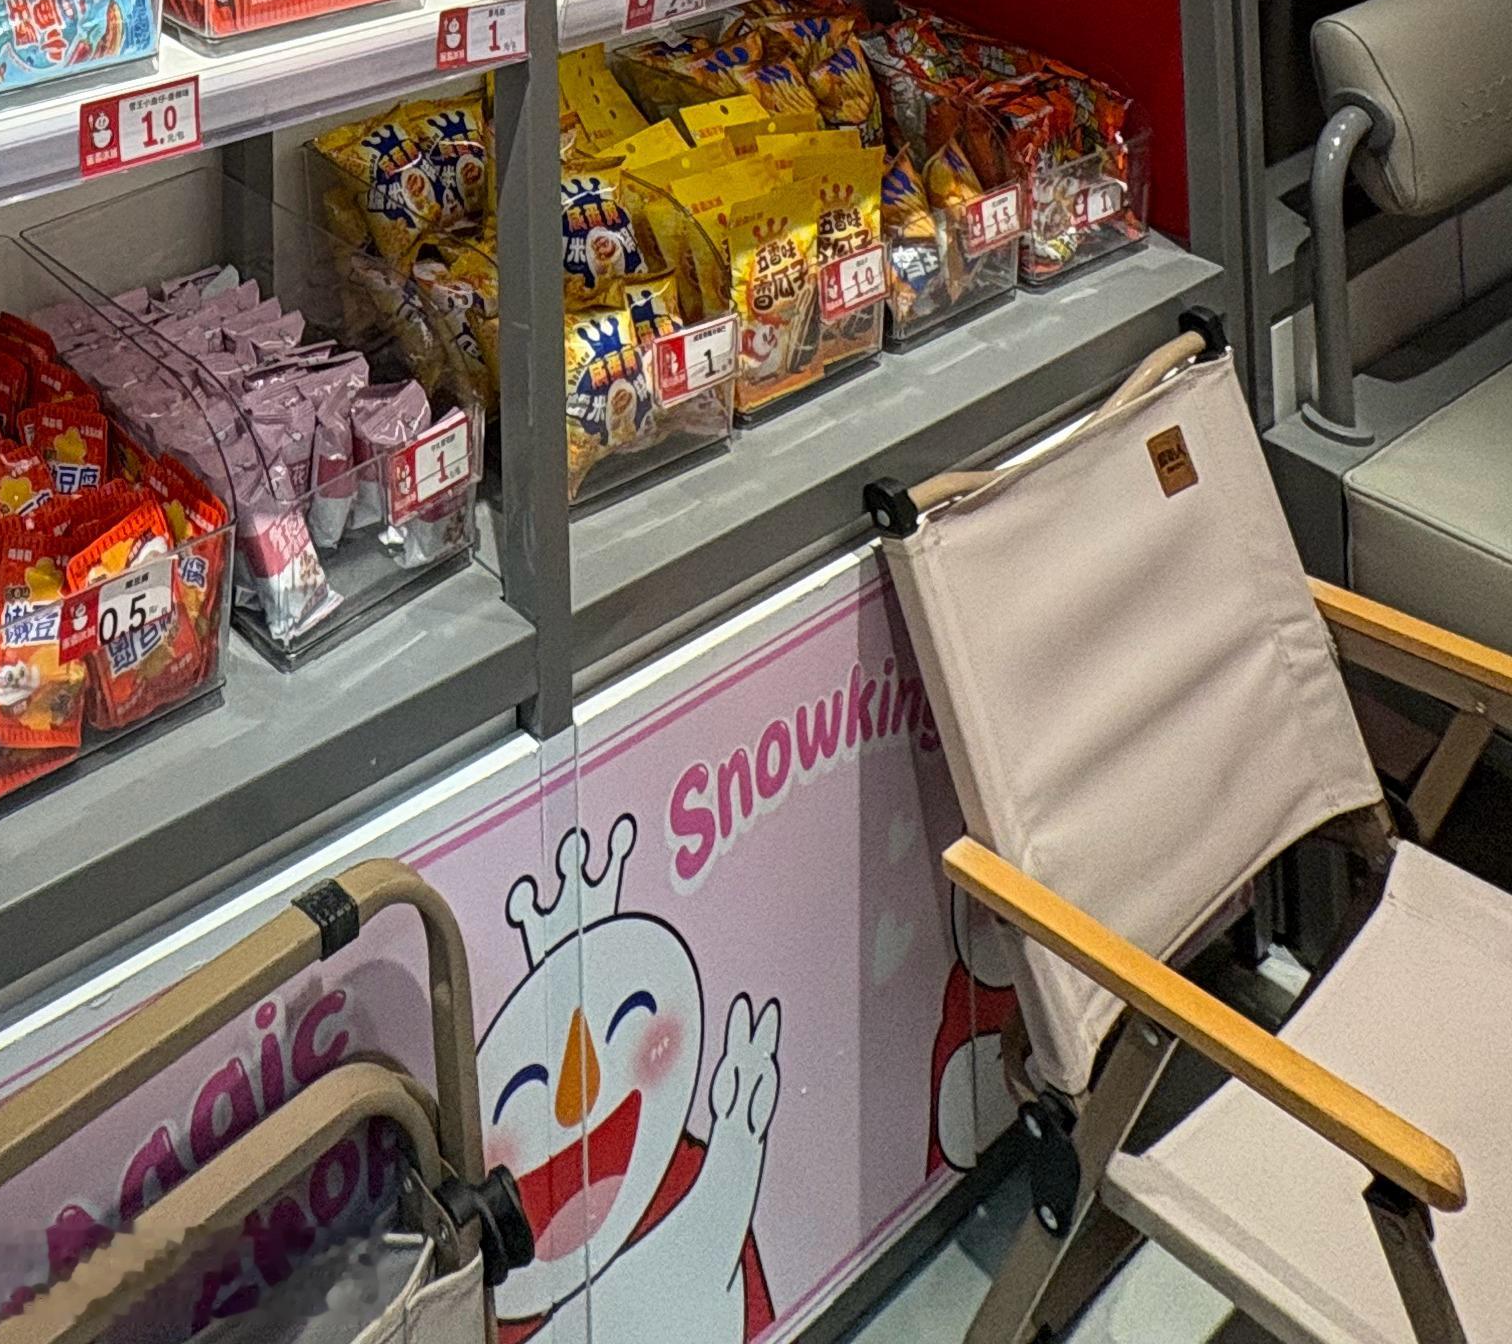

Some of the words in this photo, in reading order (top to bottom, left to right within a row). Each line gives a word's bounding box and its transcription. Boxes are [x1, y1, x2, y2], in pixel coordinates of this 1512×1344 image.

[488, 20, 502, 51] 1
[141, 104, 177, 149] 1.0
[754, 238, 796, 271] 五香味
[751, 262, 807, 313] 香瓜子
[705, 349, 717, 378] 1
[435, 451, 448, 485] 1
[2, 596, 62, 646] 嫩豆
[98, 593, 148, 647] 0.5
